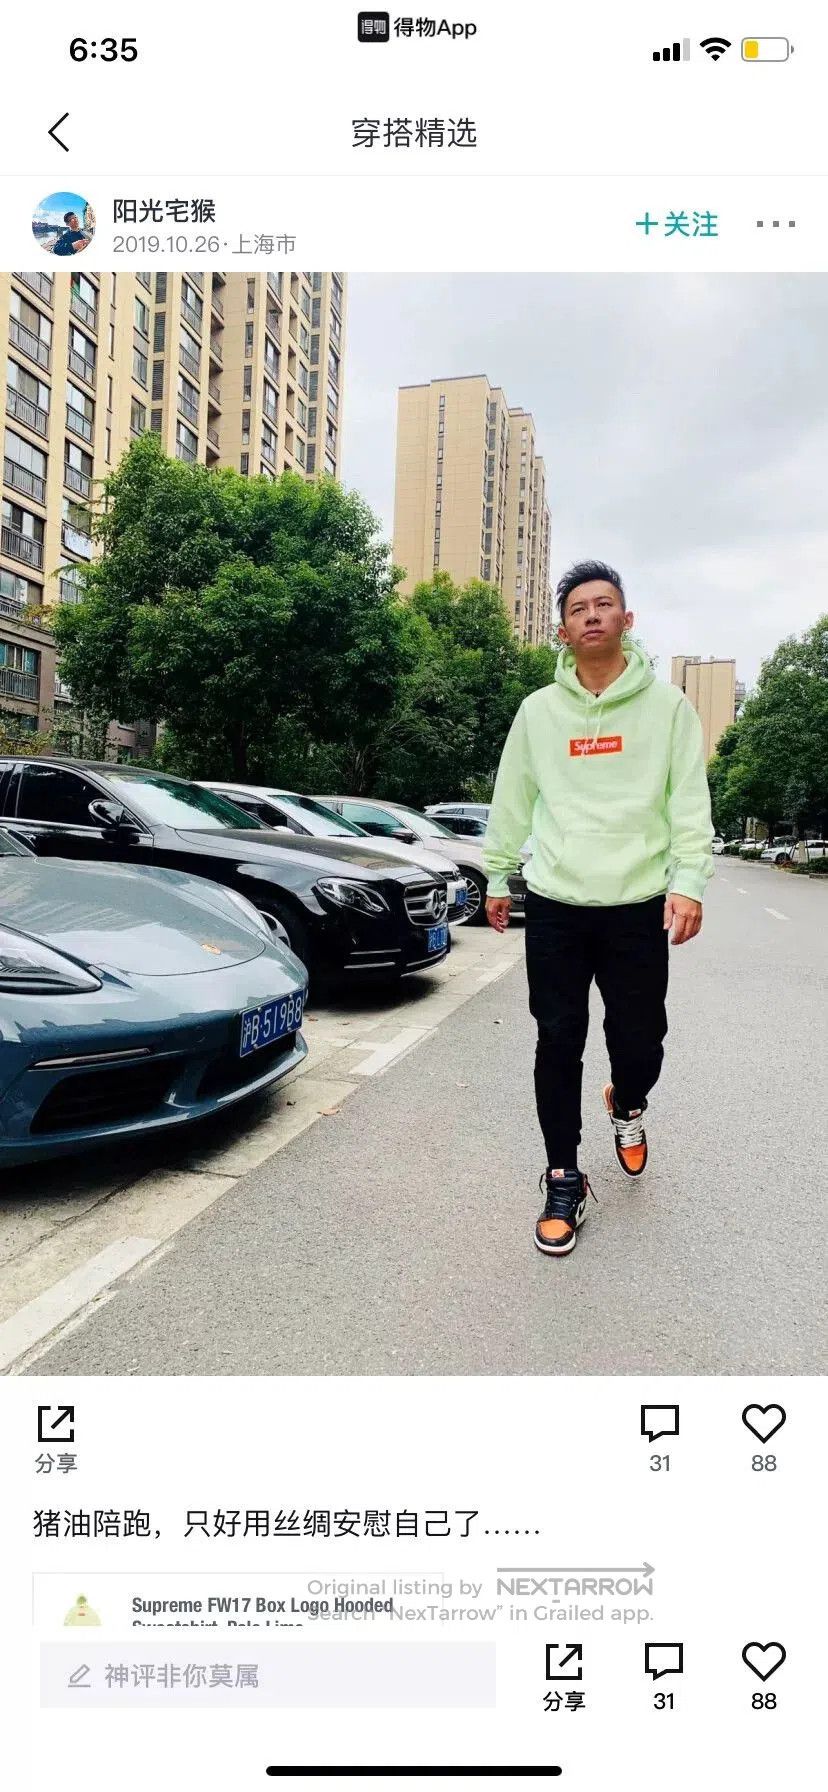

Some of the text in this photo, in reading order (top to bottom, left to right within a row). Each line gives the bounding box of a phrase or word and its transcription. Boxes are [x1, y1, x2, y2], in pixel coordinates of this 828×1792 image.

[394, 17, 477, 39] 得物App
[70, 38, 138, 62] 6:35
[352, 117, 476, 148] 穿搭精选
[113, 198, 216, 224] 阳光宅猴
[574, 740, 618, 753] Supreme
[35, 1453, 78, 1474] 分享
[649, 1455, 670, 1472] 31
[752, 1455, 777, 1472] 88
[132, 1597, 393, 1616] Supreme FW17 Box Logo Hooded
[105, 1663, 259, 1689] 神评非你莫属
[543, 1691, 587, 1713] 分享
[653, 1693, 673, 1711] 31
[752, 1693, 777, 1711] 88
